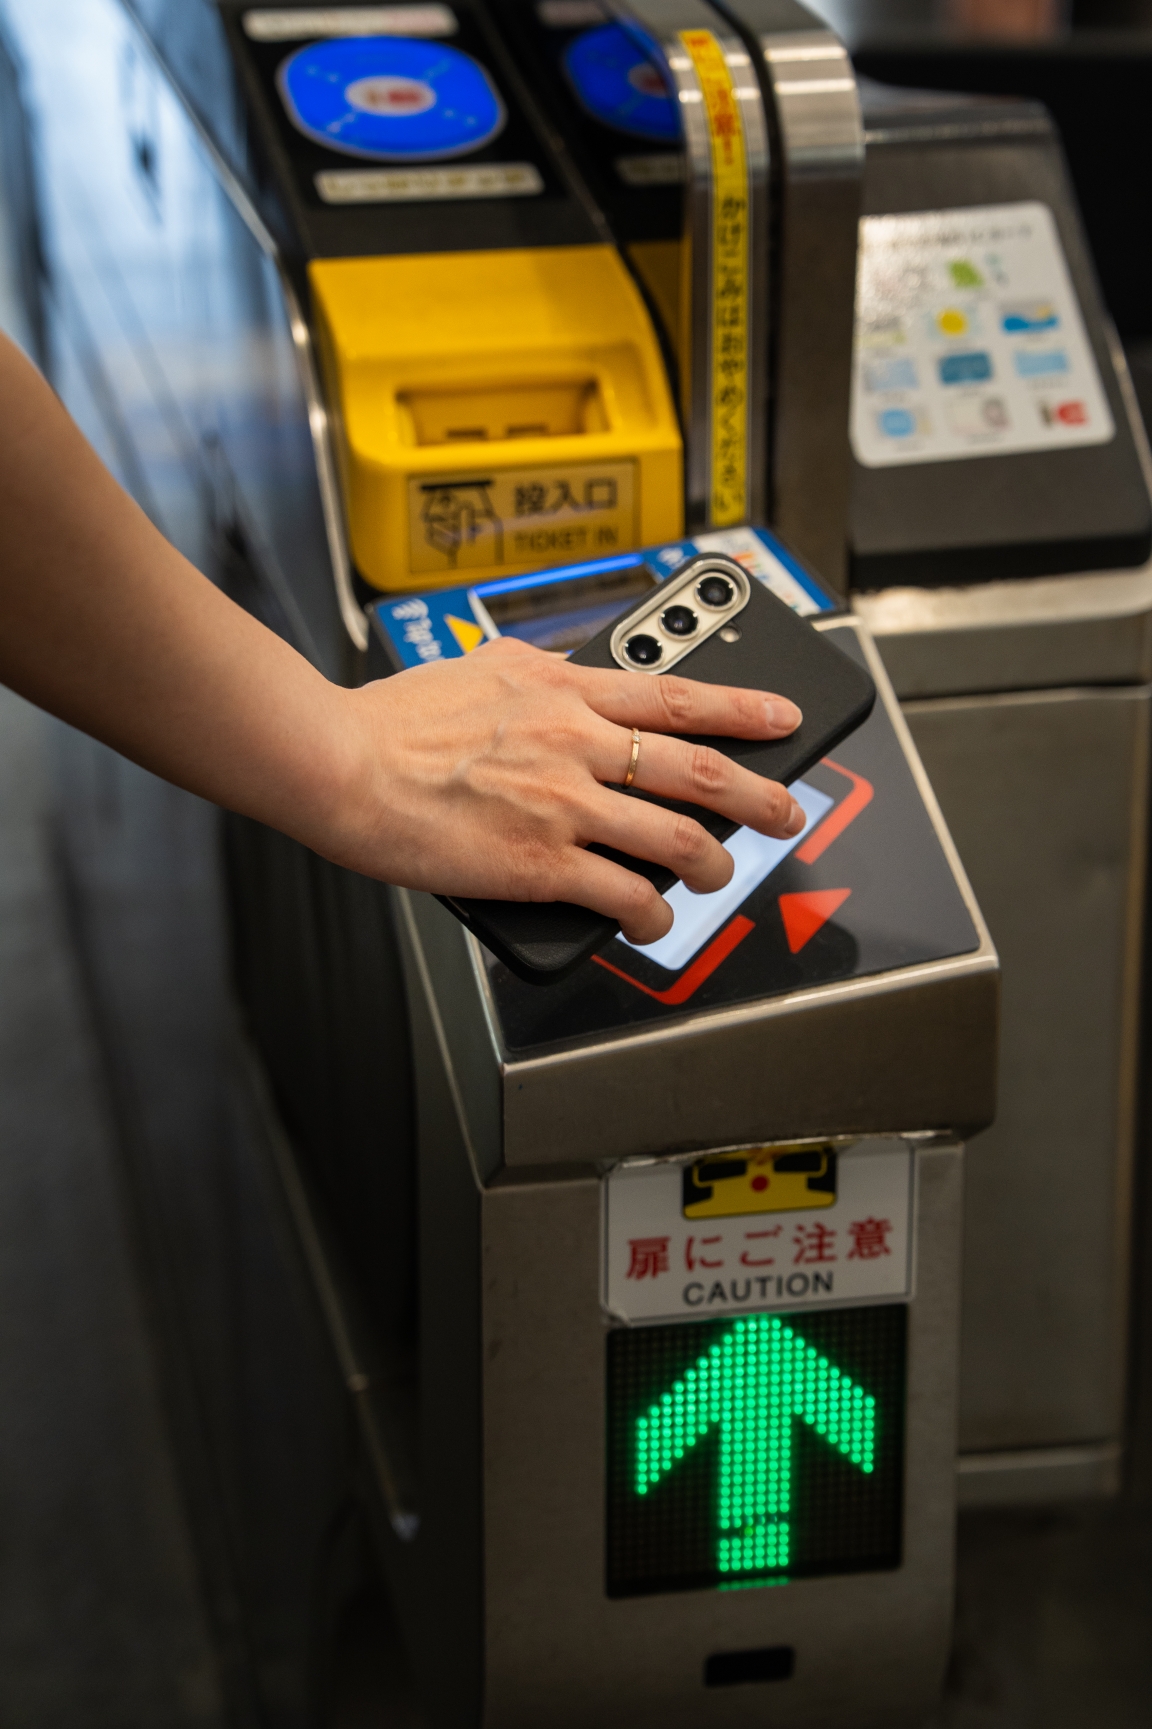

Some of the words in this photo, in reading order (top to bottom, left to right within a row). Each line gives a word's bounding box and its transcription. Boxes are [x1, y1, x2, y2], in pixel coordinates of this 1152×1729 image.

[515, 476, 618, 518] 投入口
[514, 527, 587, 552] TICKET
[596, 525, 618, 546] IN
[625, 1217, 893, 1281] 扉にご注意
[682, 1270, 835, 1307] CAUTION
